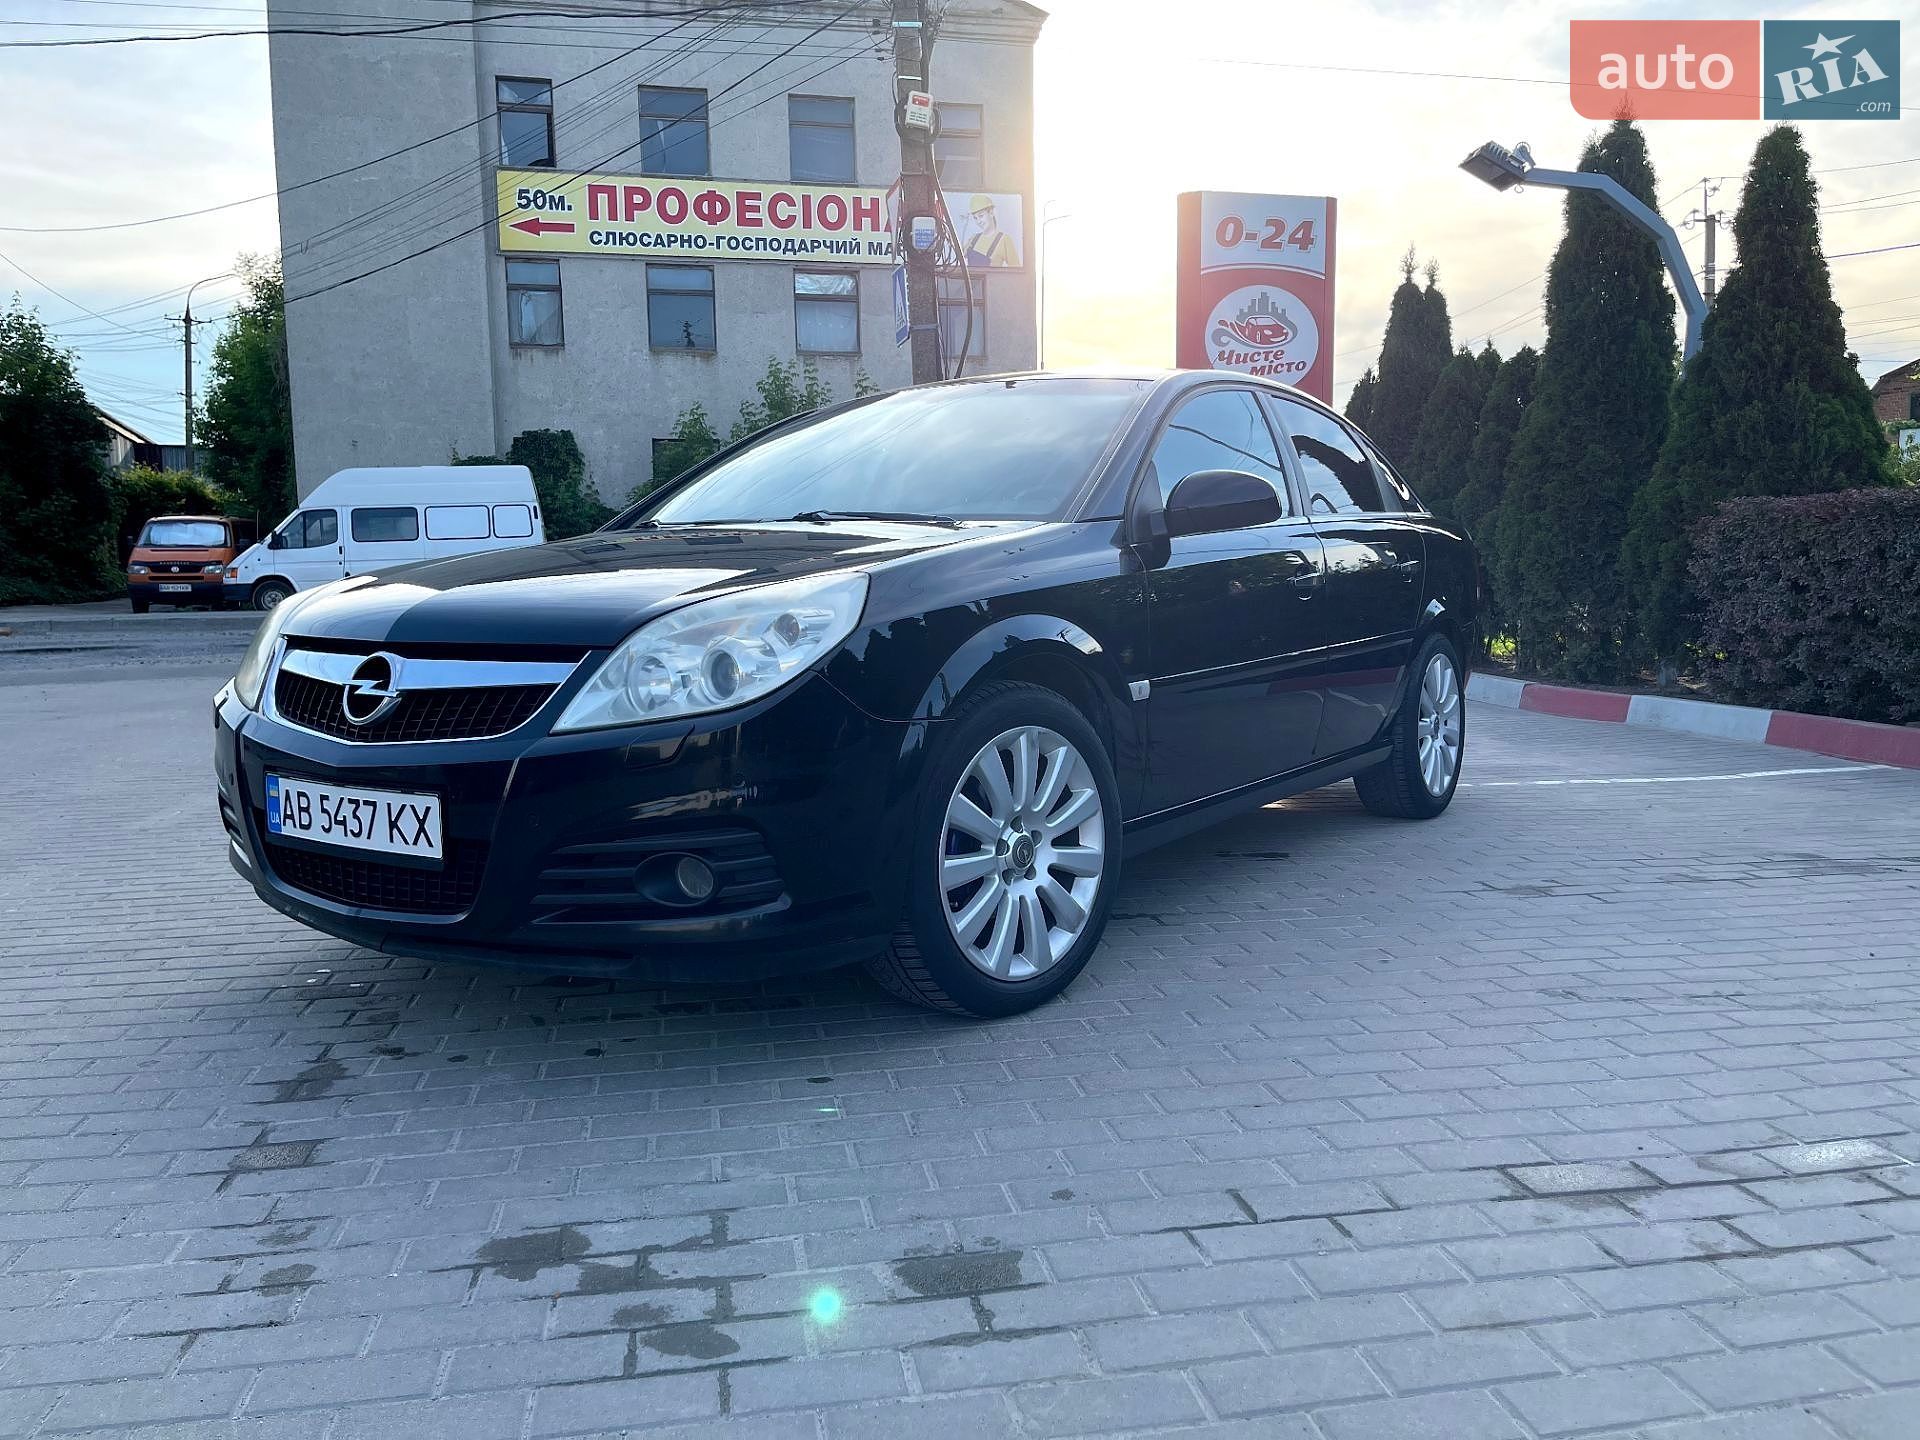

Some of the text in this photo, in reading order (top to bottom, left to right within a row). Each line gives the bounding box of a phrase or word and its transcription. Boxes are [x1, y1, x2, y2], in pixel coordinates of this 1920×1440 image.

[587, 184, 892, 233] ПРОФЕСІОН
[589, 230, 861, 256] СЛЮСАРНО-ГОСПОДАРЧИЙ
[1215, 216, 1315, 251] 0-24
[1218, 349, 1285, 365] Чисте
[1249, 360, 1307, 376] місто
[283, 789, 434, 848] AB 5437 KX
